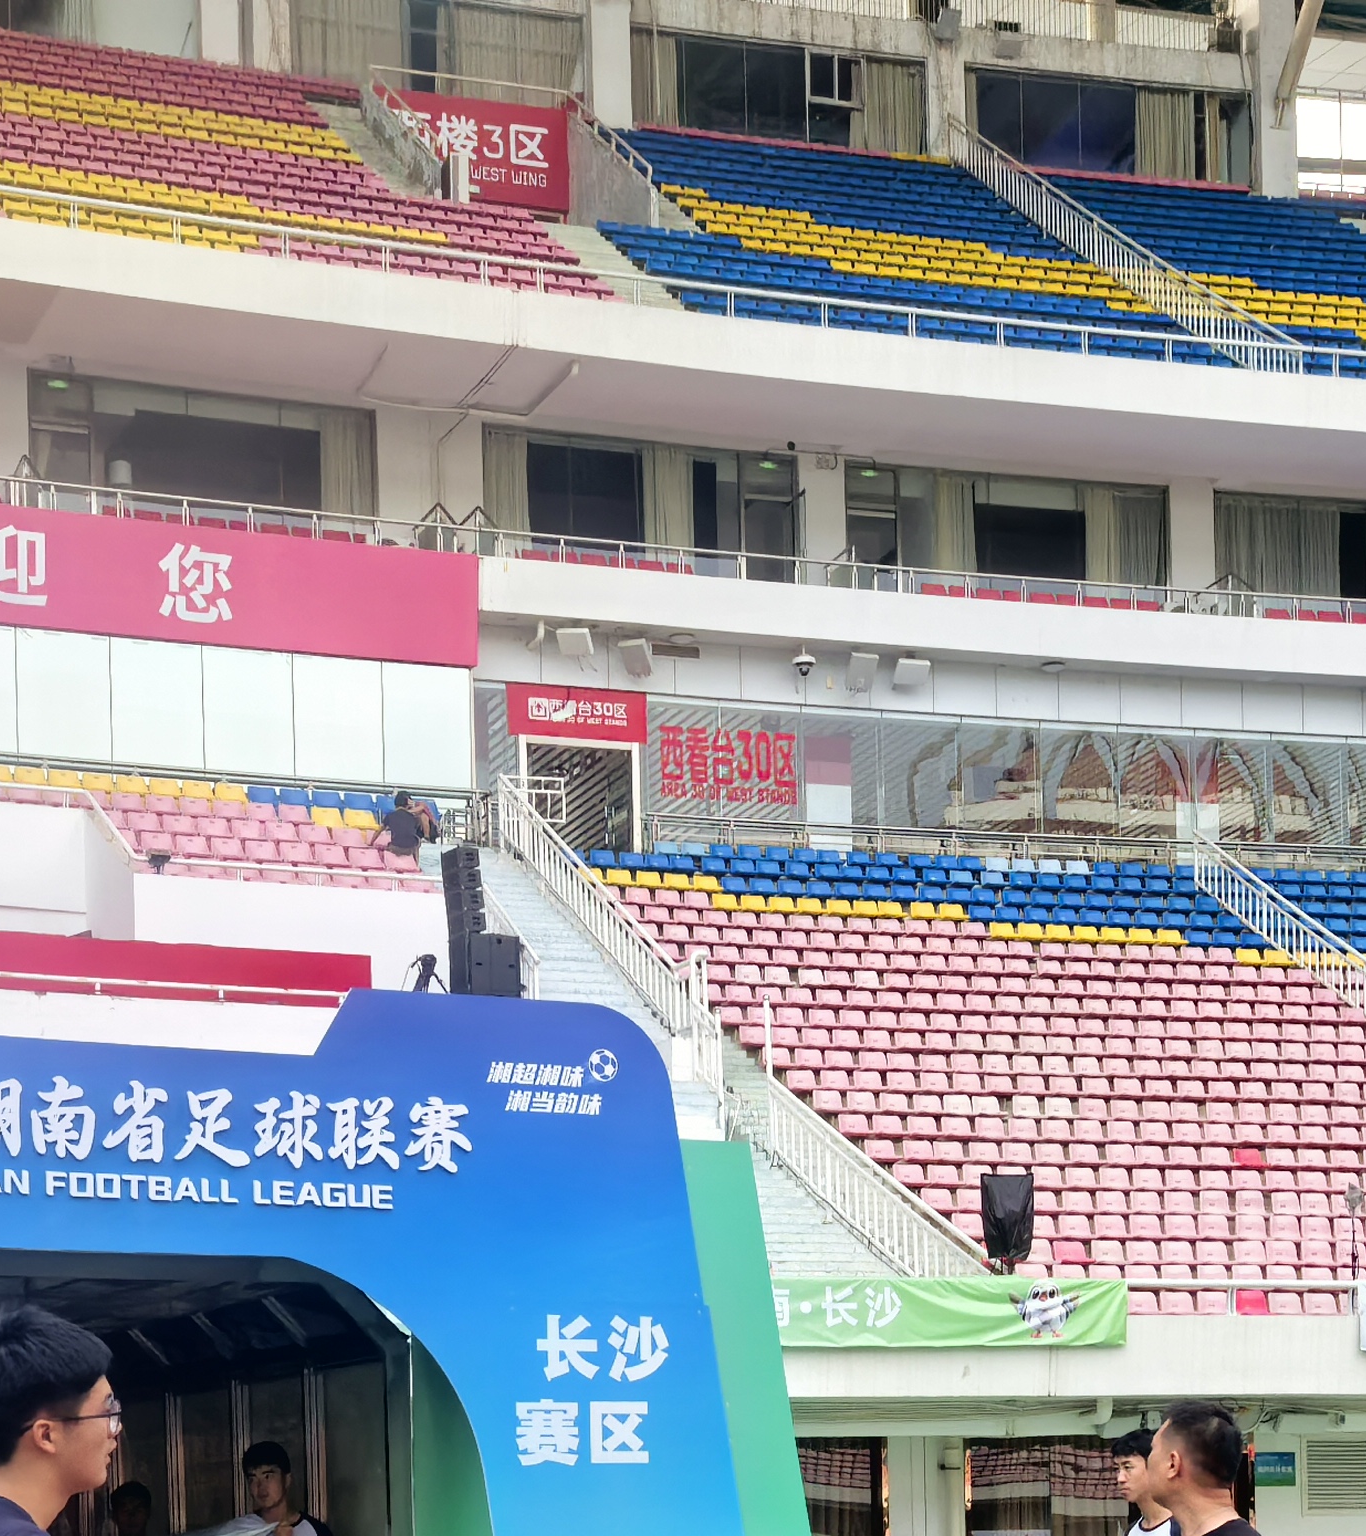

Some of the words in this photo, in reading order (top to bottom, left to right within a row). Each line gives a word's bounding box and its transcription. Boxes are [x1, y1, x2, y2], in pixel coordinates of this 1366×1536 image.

[471, 163, 507, 182] WEST
[512, 171, 547, 188] WING
[549, 698, 628, 719] 西台30区
[660, 725, 798, 787] 西看台30区
[486, 1061, 585, 1087] 湘超湘味
[504, 1089, 603, 1115] 湘当韵味
[46, 1170, 239, 1205] FOOTBALL
[252, 1179, 394, 1210] LEAGUE
[536, 1314, 670, 1382] 长沙
[515, 1398, 650, 1466] 赛区
